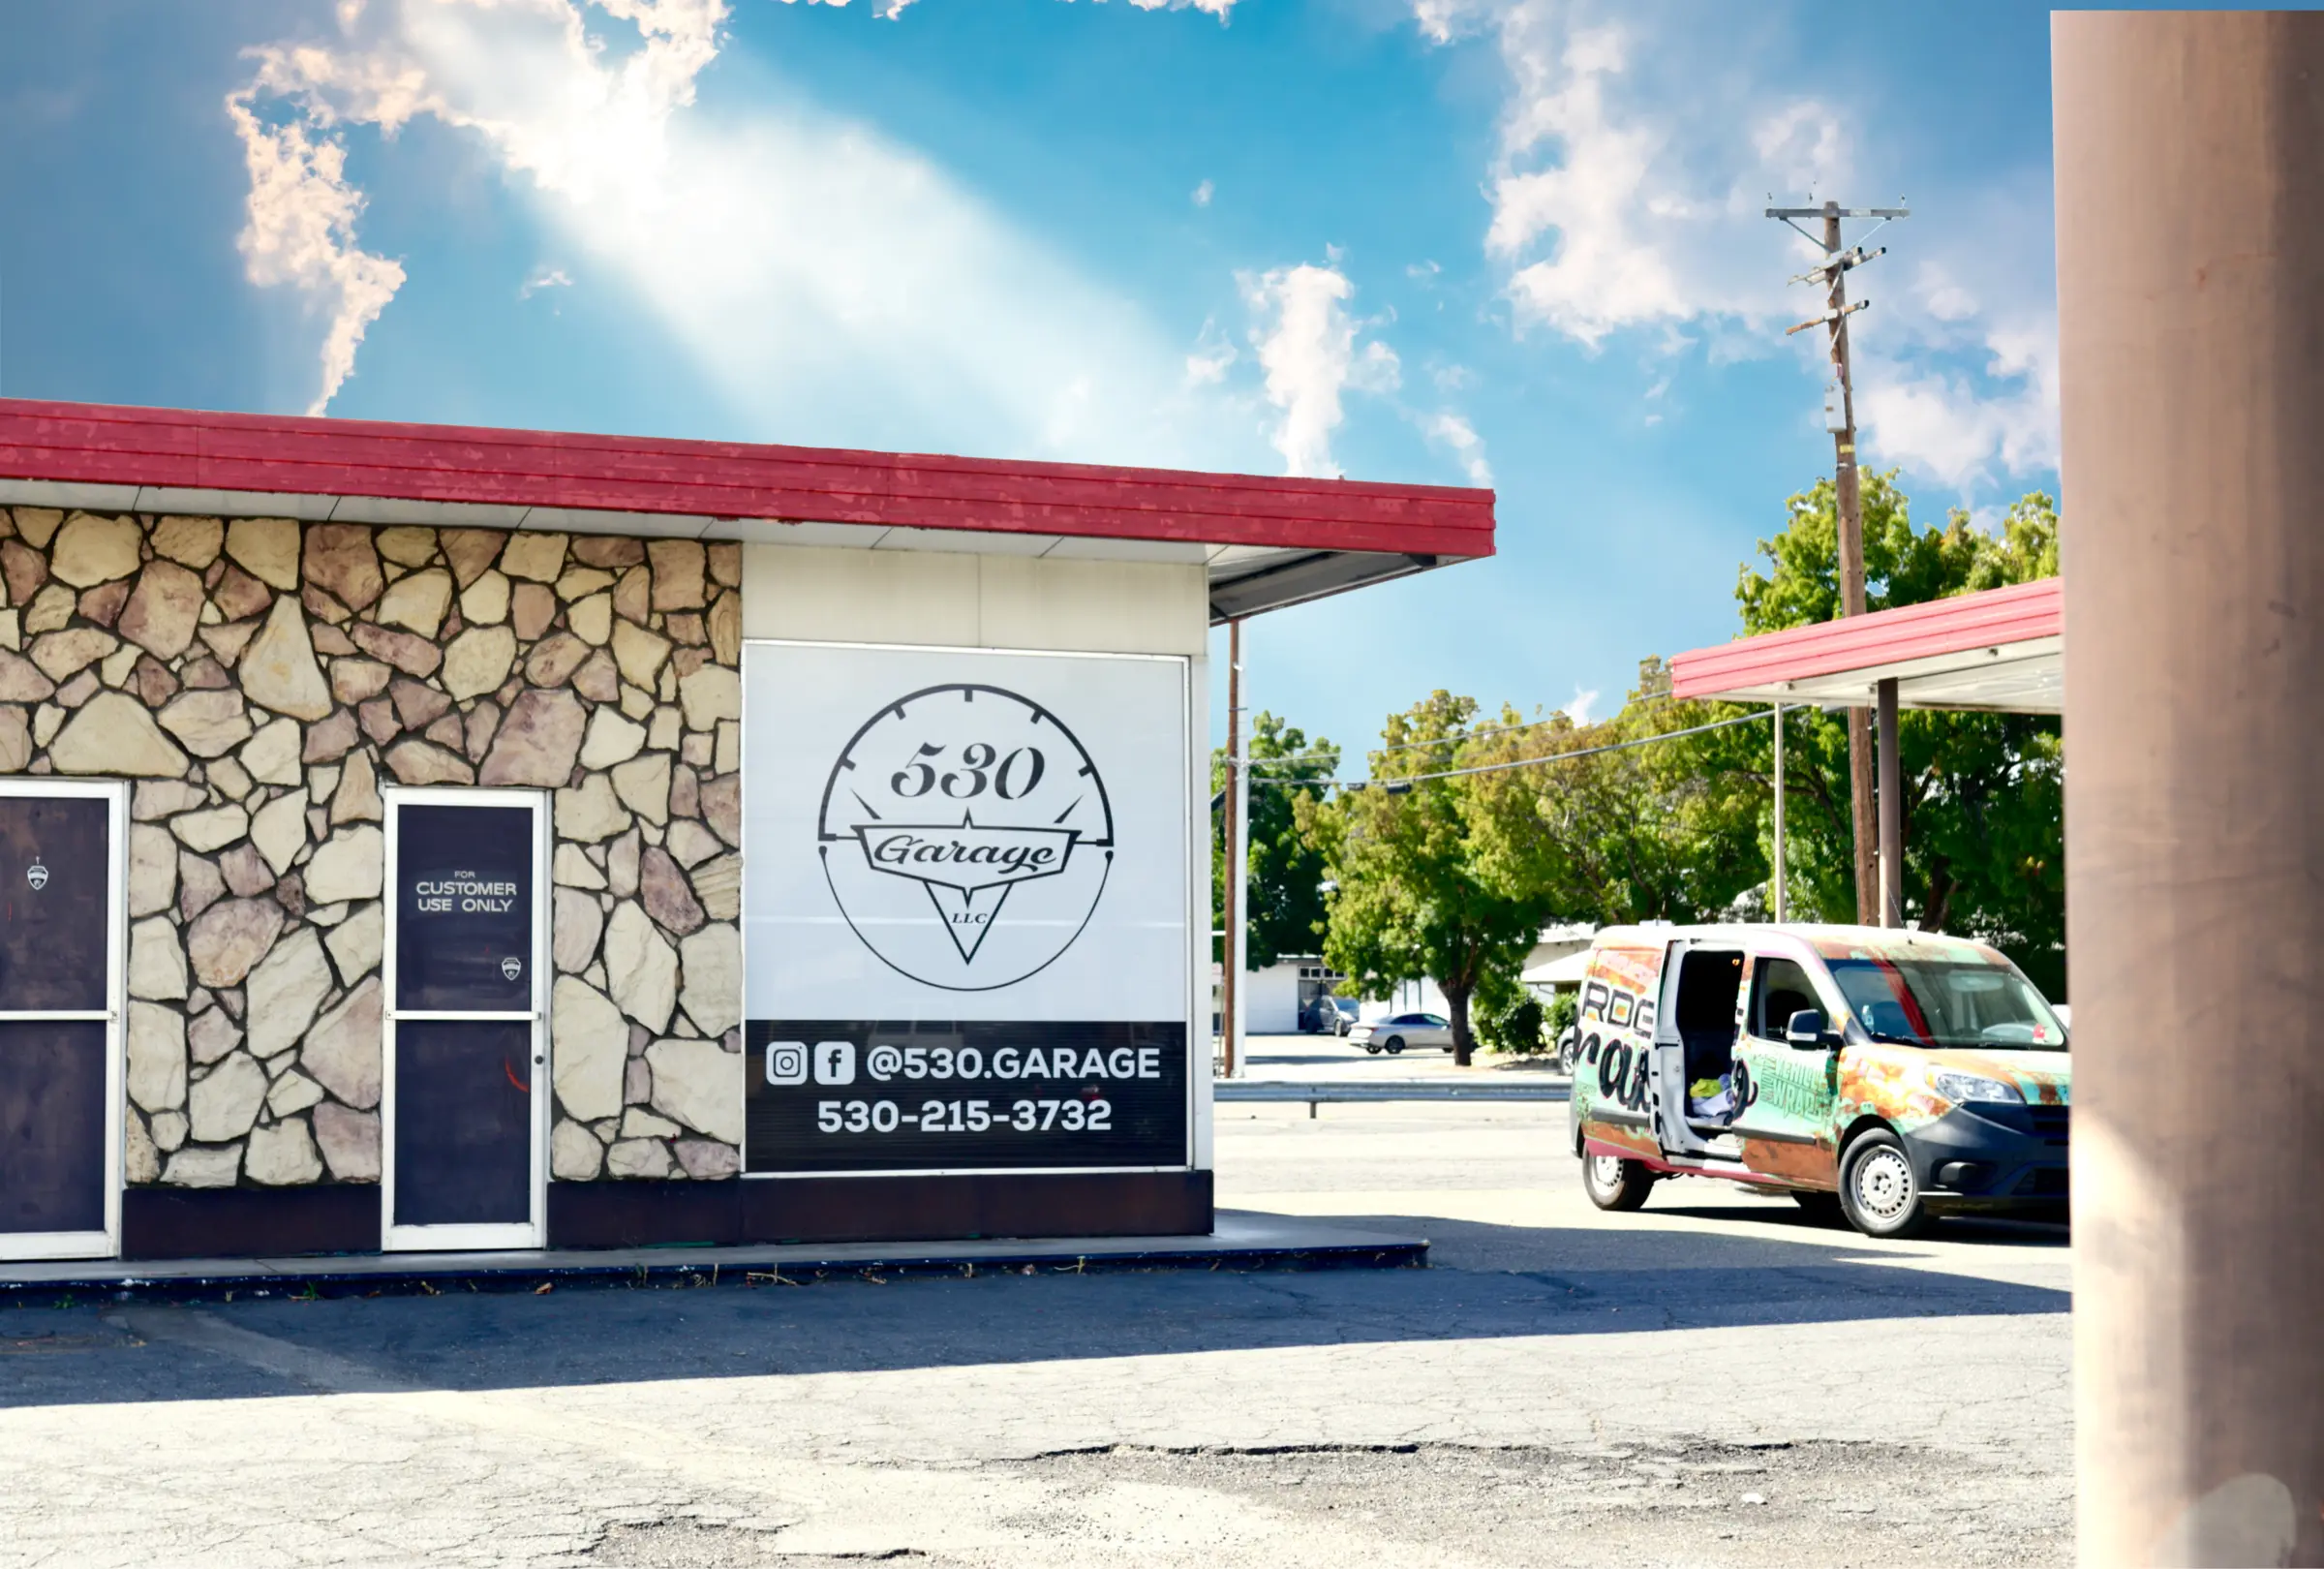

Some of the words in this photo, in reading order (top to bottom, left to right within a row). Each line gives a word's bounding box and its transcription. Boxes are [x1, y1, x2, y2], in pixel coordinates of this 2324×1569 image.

[891, 742, 1045, 800] 530
[873, 834, 1056, 875] Garage
[454, 870, 476, 879] FOR
[415, 881, 518, 897] CUSTOMER
[417, 897, 453, 912] USE
[461, 897, 514, 912] ONLY
[952, 912, 988, 925] LLC
[868, 1046, 1160, 1081] @530.GARAGE
[818, 1100, 1112, 1132] 530-215-3732
